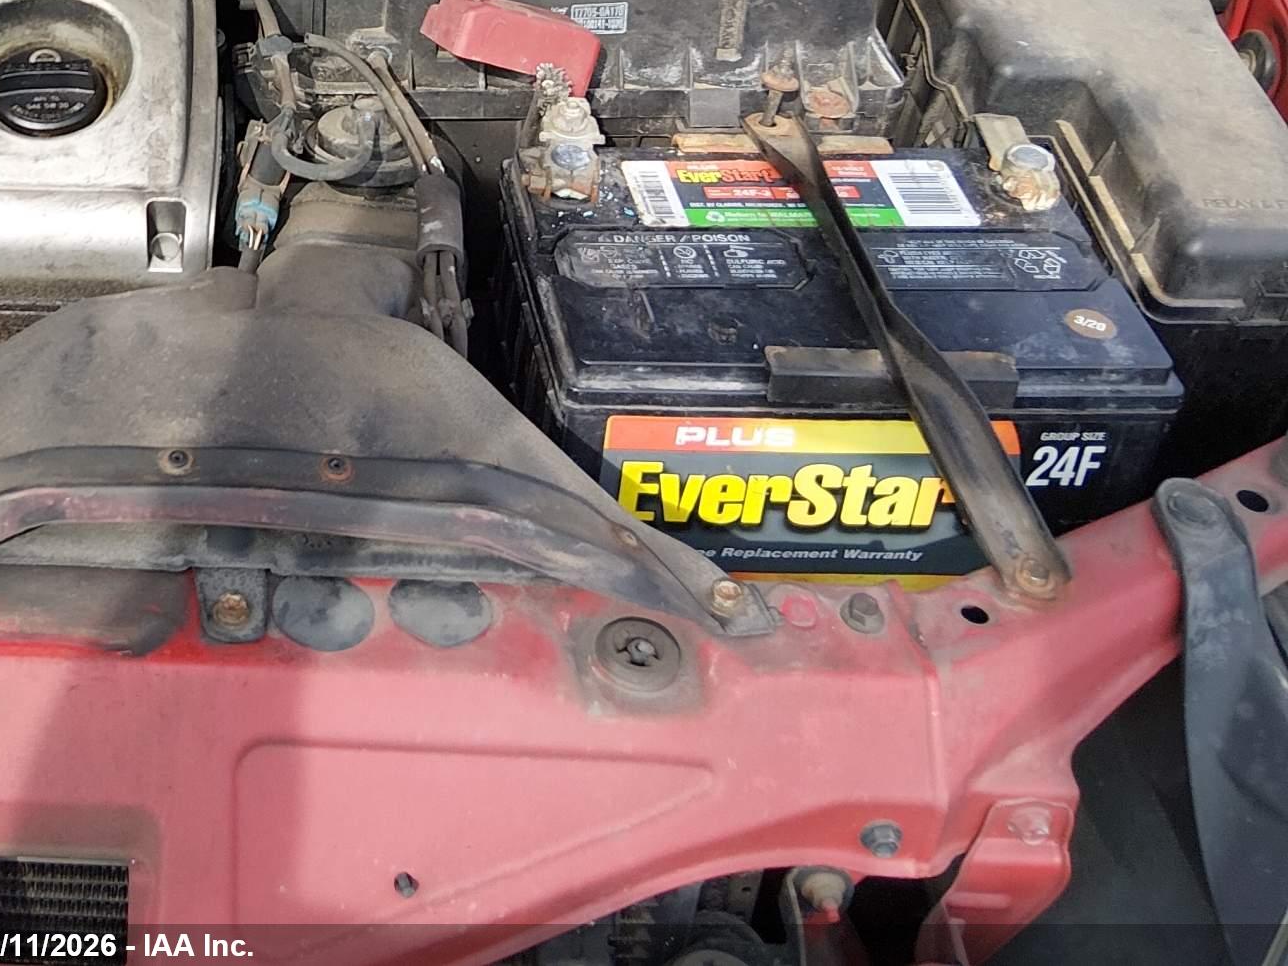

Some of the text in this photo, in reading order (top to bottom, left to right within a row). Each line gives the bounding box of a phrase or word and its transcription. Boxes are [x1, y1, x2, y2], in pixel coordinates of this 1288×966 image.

[676, 169, 776, 184] EverStart
[613, 234, 675, 243] DANGER
[691, 233, 751, 243] POISON
[675, 425, 796, 447] PLUS
[1040, 431, 1107, 442] GROUP SIZE
[1025, 445, 1107, 487] 24F
[619, 460, 954, 526] EverStar
[721, 547, 838, 560] Replacement
[843, 548, 923, 562] Warranty
